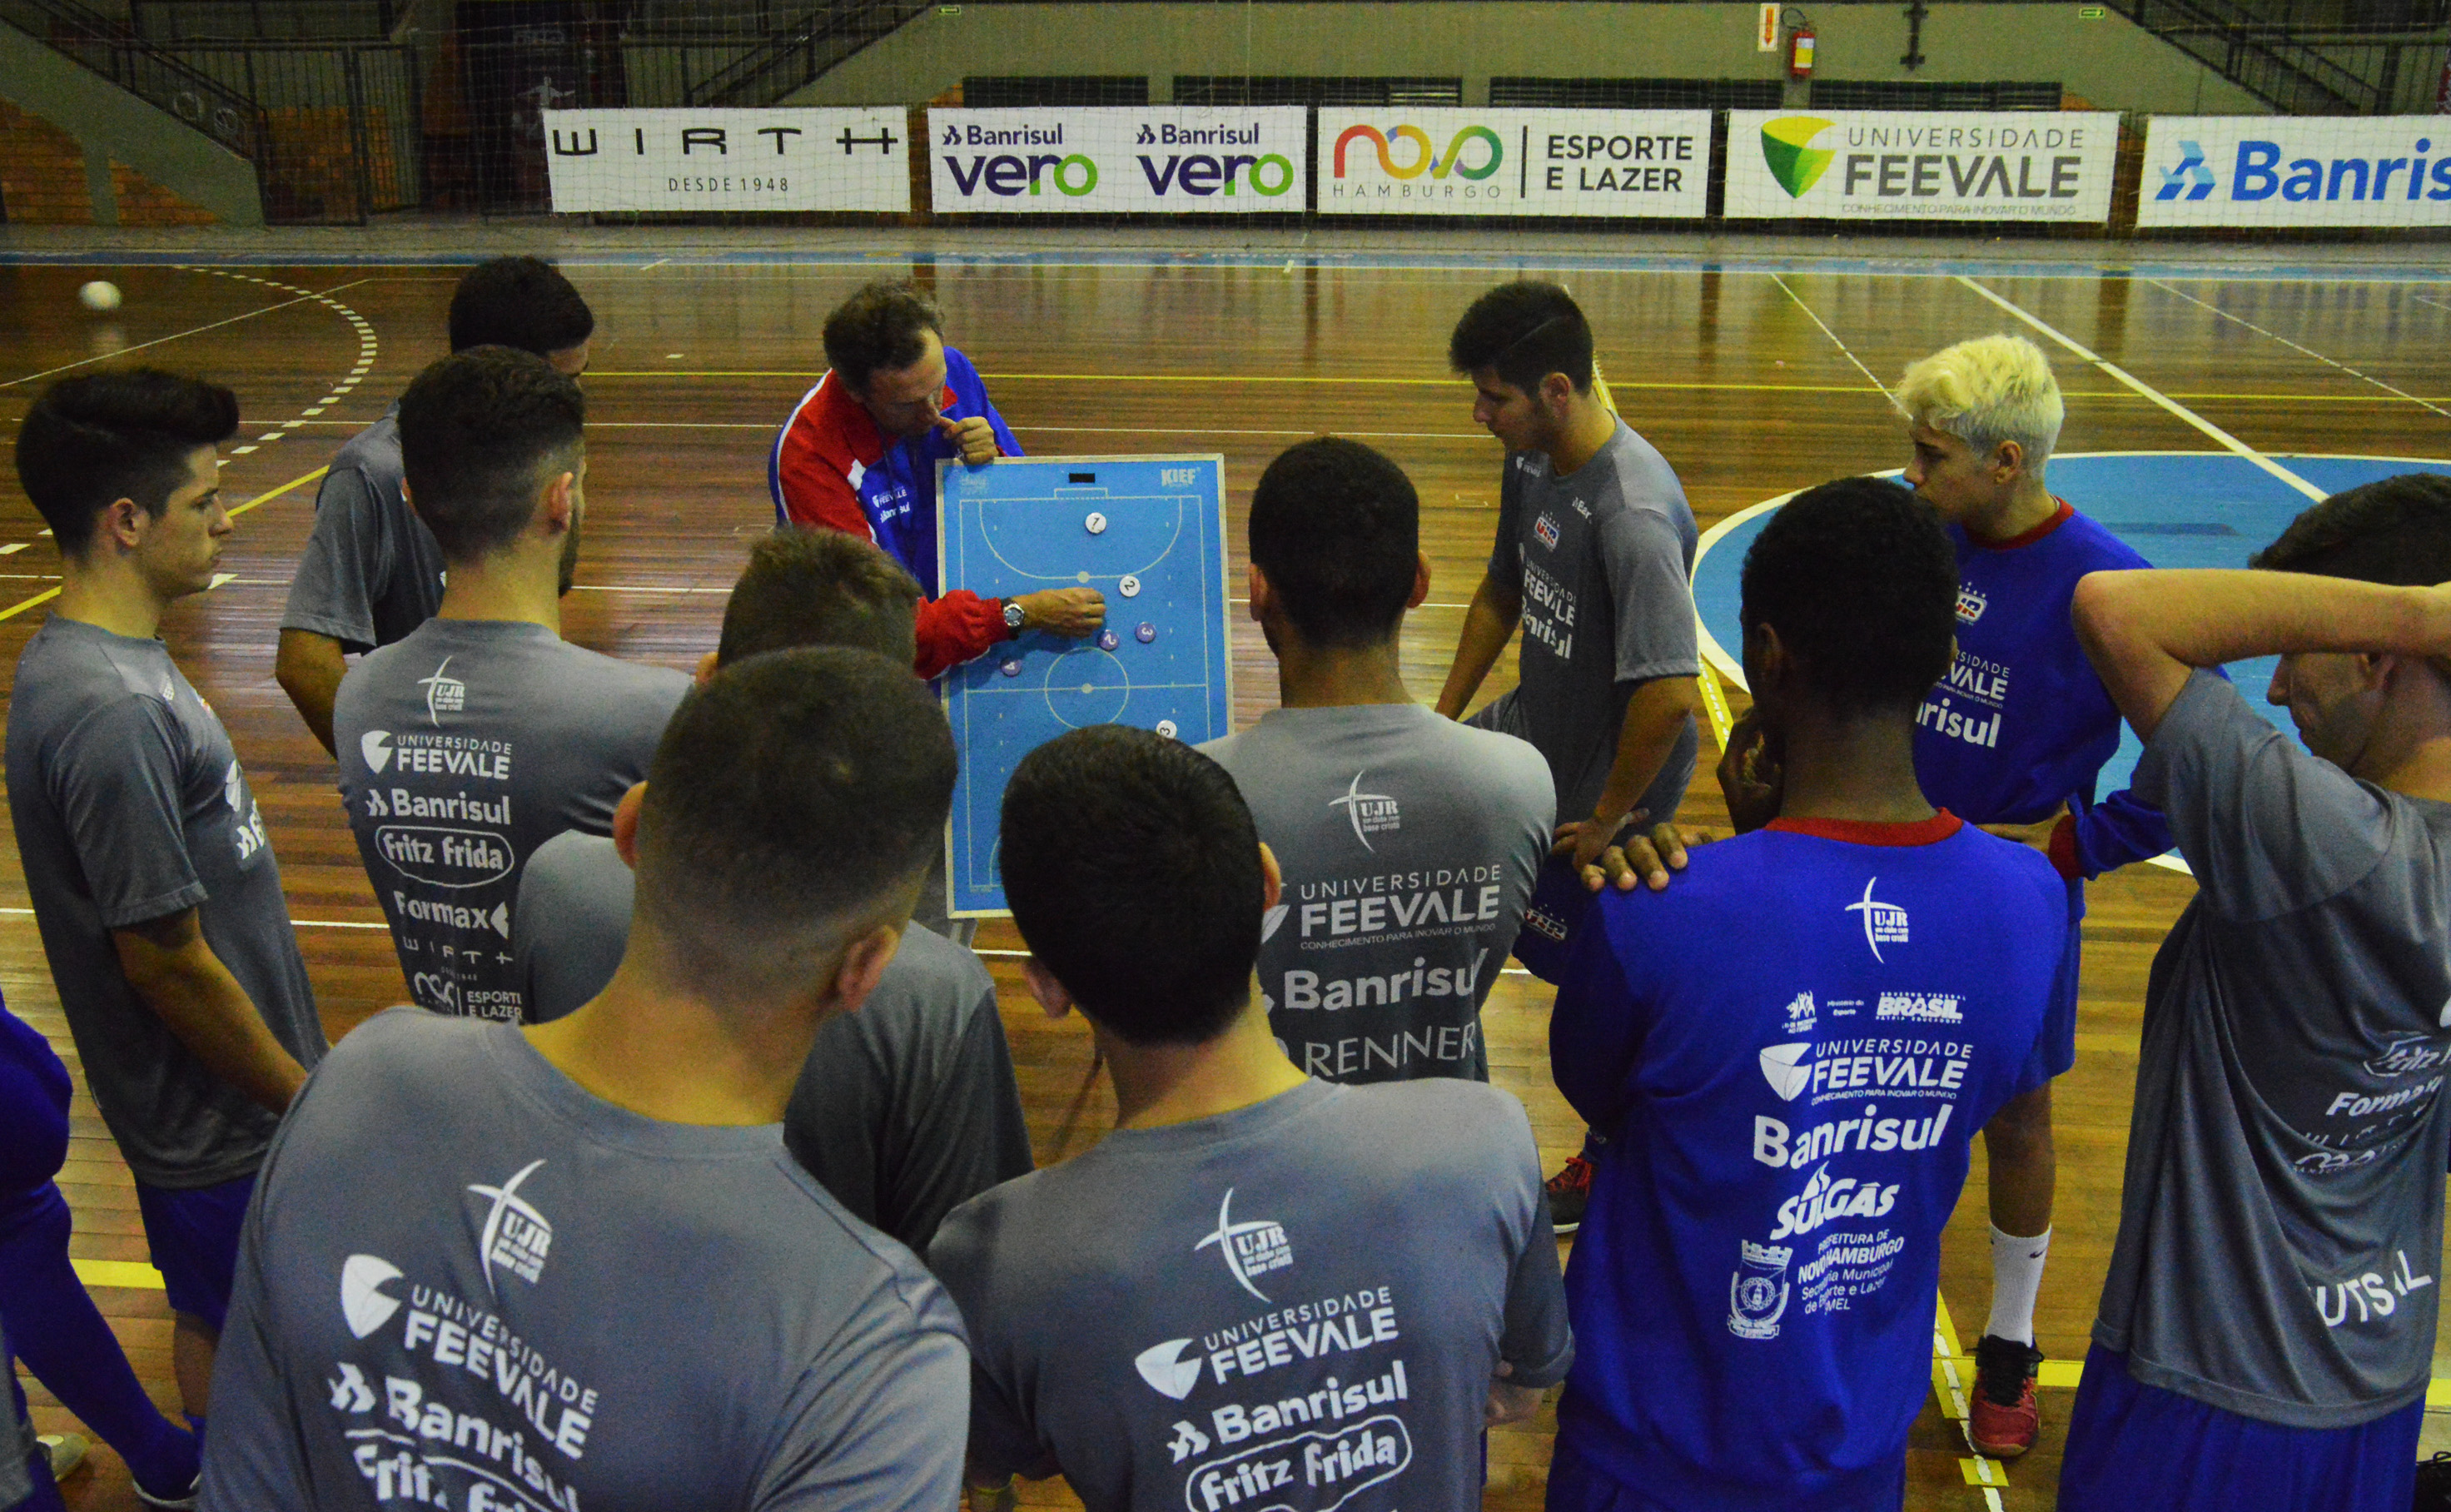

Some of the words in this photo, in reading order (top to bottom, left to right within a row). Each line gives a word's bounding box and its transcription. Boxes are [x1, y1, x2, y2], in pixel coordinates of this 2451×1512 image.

[553, 127, 898, 157] WIRTH
[967, 123, 1063, 146] Banrisul
[1161, 123, 1260, 145] Banrisul
[1547, 135, 1693, 160] ESPORTE
[1848, 127, 2084, 148] UNIVERSIDADE
[669, 178, 731, 191] DESDE
[741, 178, 788, 191] 1948
[942, 153, 1098, 196] vero
[1136, 153, 1294, 196] vero
[1547, 167, 1563, 191] E
[1579, 167, 1683, 192] LAZER
[1845, 154, 2082, 198] FEEVALE
[1333, 185, 1501, 199] HAMBURGO
[1161, 468, 1196, 486] KIEF
[397, 734, 513, 755] UNIVERSIDADE
[397, 748, 510, 780] FEEVALE
[391, 788, 511, 825] Banrisul
[1360, 800, 1399, 816] UJR
[384, 833, 435, 864] Fritz
[443, 836, 504, 869] Frida
[1300, 864, 1501, 901] UNIVERSIDADE
[394, 890, 490, 930] Formax
[1300, 884, 1501, 938] FEEVALE
[1874, 911, 1908, 927] UJR
[1300, 935, 1385, 951] CONHECIMENTO
[1386, 931, 1413, 942] PARA
[1414, 927, 1452, 938] INOVAR
[1877, 997, 1964, 1021] BRASIL
[1305, 1021, 1476, 1077] RENNER
[1815, 1038, 1974, 1059] UNIVERSIDADE
[1812, 1057, 1969, 1094] FEEVALE
[1752, 1103, 1954, 1170] Banrisul
[1235, 1226, 1288, 1256] UJR
[1849, 1285, 1857, 1296] e
[1204, 1286, 1392, 1351] UNIVERSIDADE
[411, 1284, 599, 1415] UNIVERSIDADE
[1210, 1306, 1400, 1385] FEEVALE
[404, 1308, 592, 1460] FEEVALE
[1211, 1359, 1409, 1445] Banrisul
[1200, 1459, 1294, 1512] Fritz
[1304, 1429, 1397, 1487] Frida
